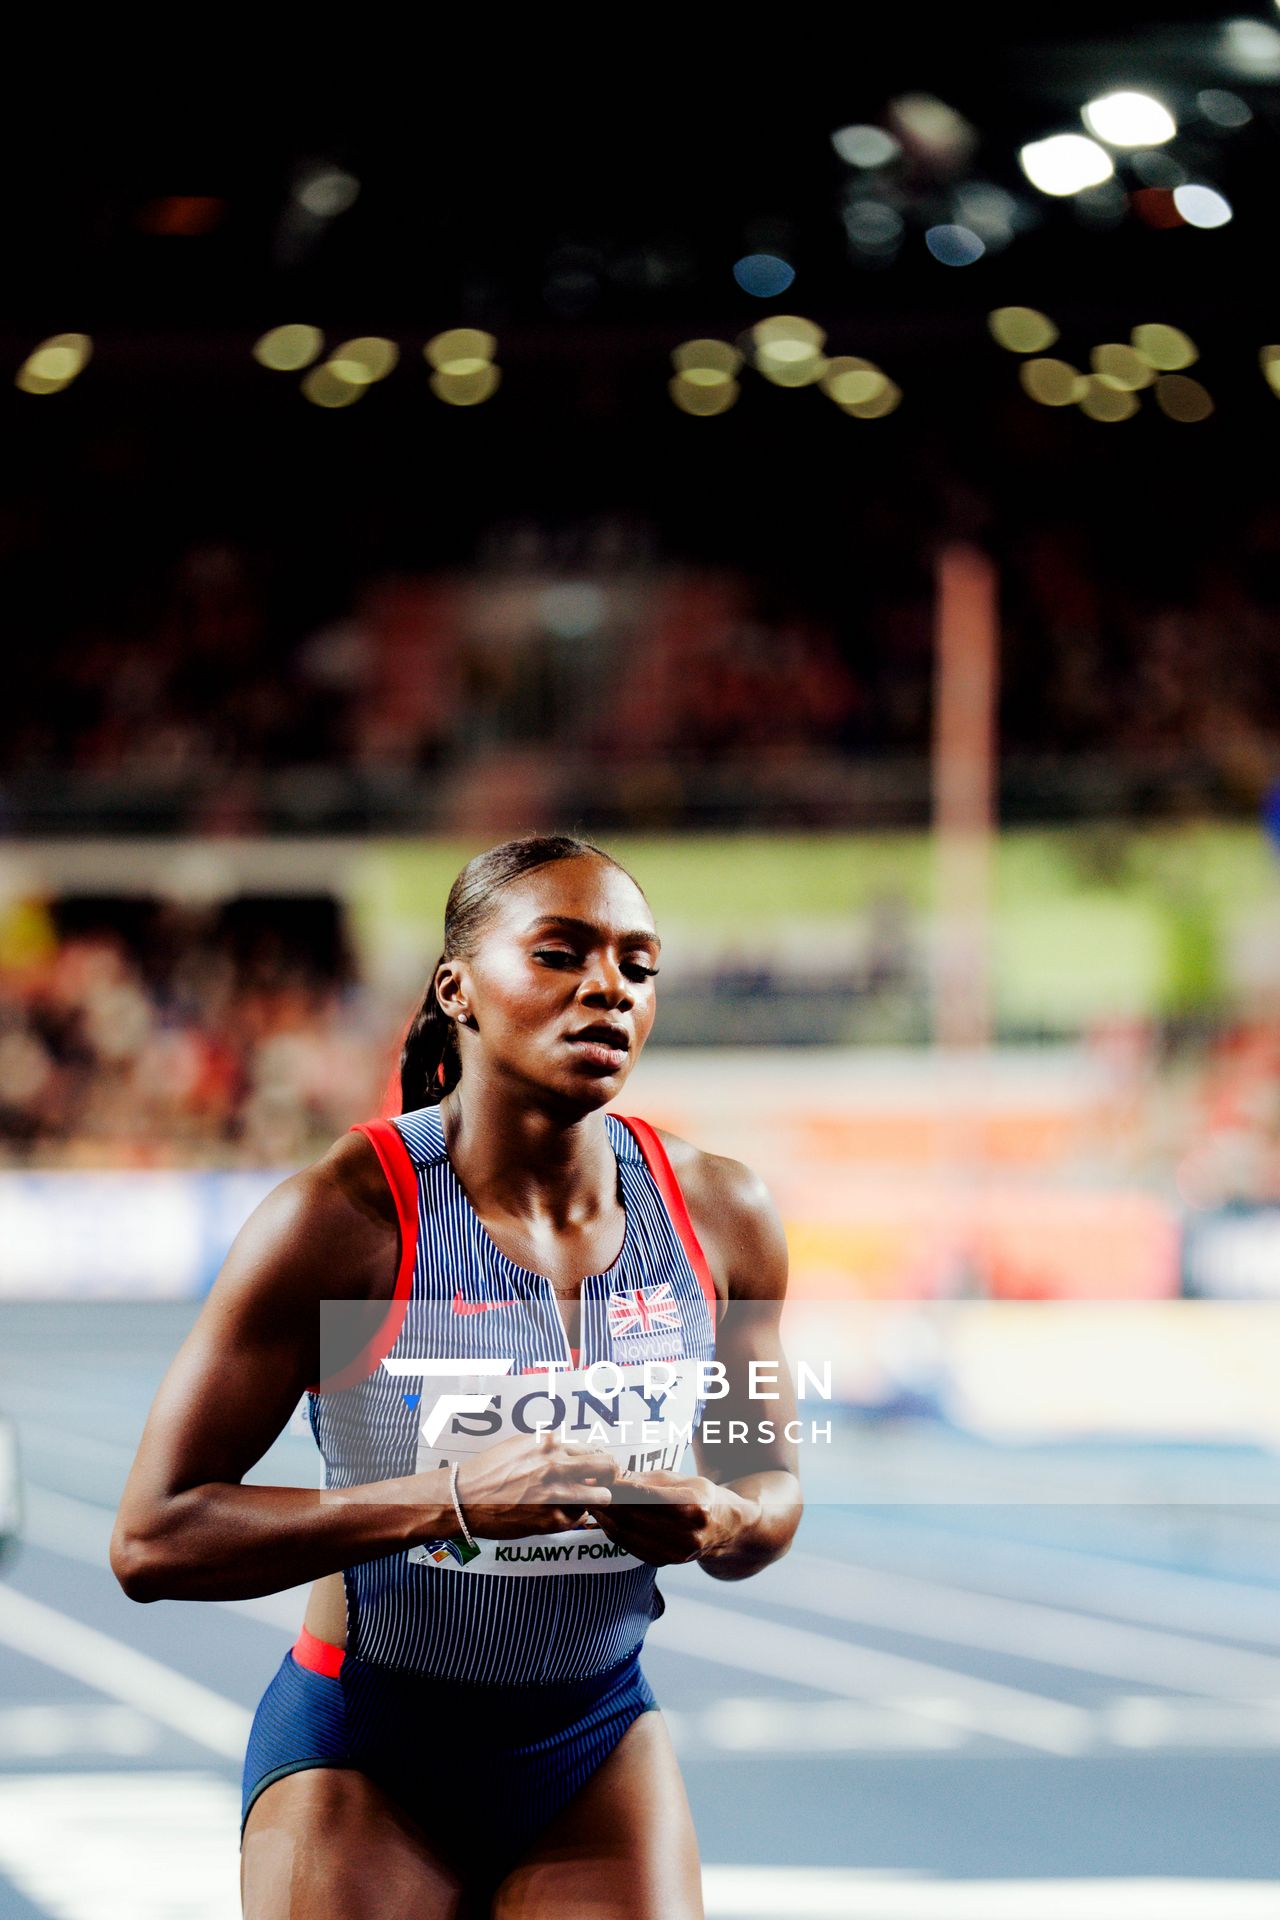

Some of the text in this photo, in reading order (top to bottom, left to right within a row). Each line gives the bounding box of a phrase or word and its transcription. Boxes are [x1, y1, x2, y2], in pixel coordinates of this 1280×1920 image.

[614, 1340, 682, 1360] Novuna
[451, 1380, 680, 1436] SONY
[495, 1546, 574, 1562] KUJAWY
